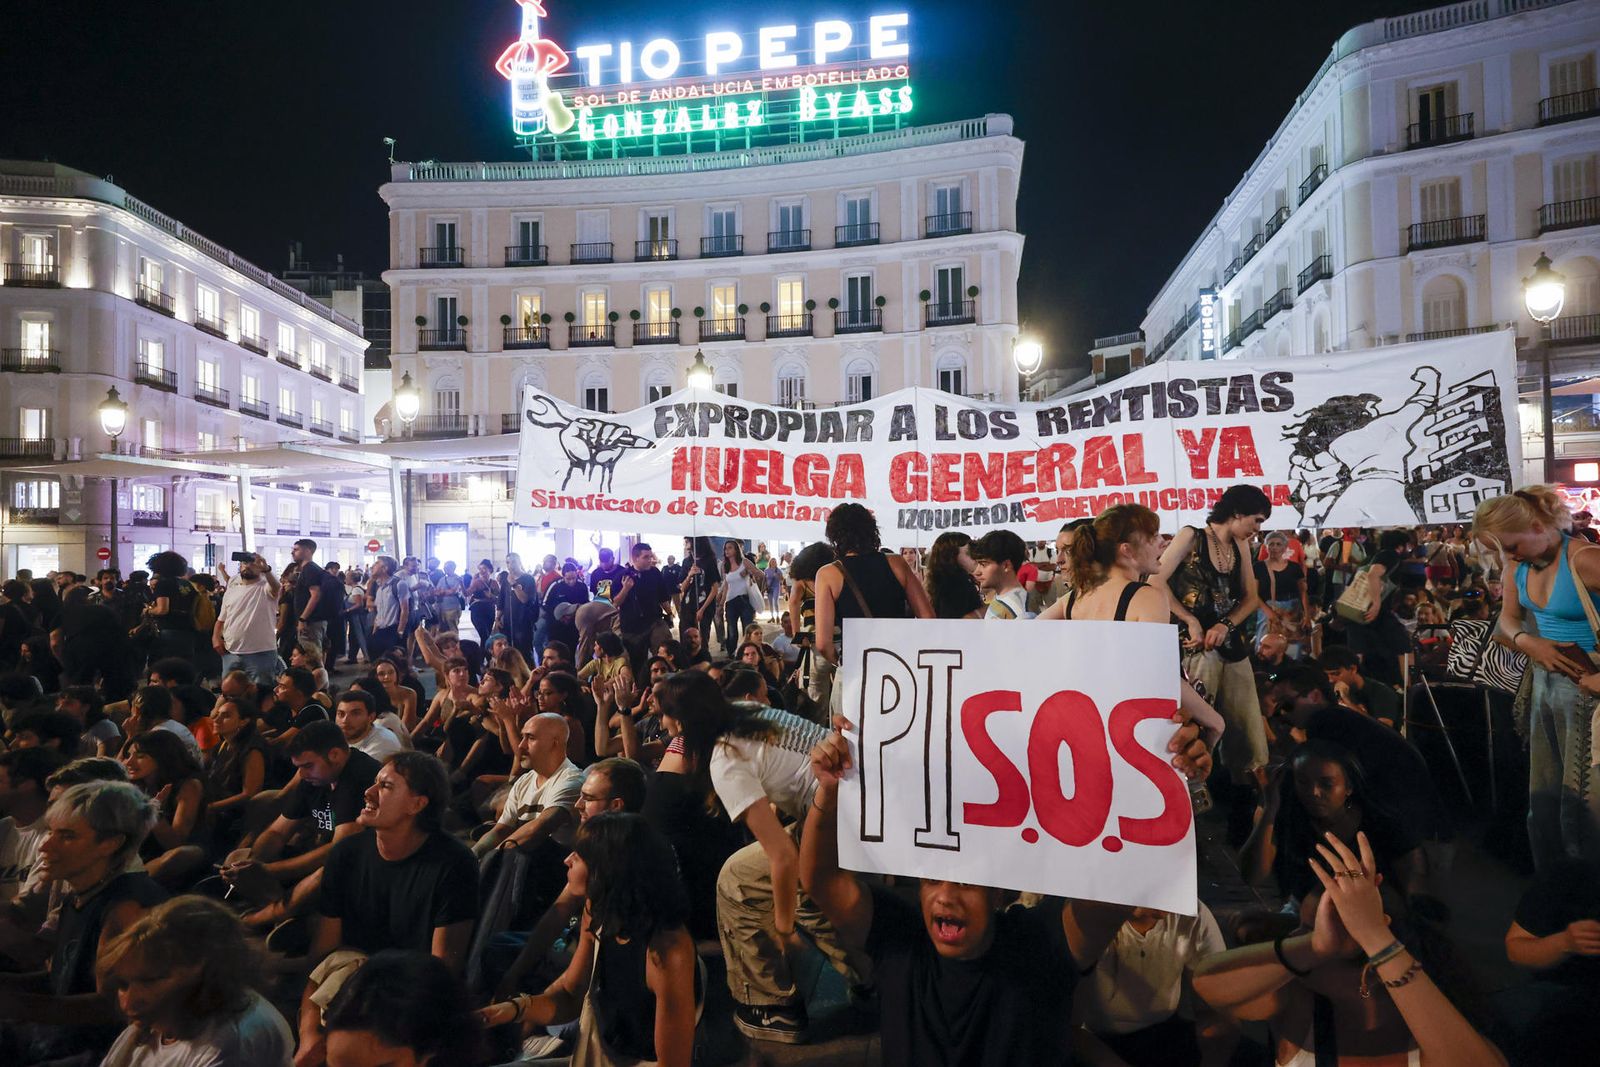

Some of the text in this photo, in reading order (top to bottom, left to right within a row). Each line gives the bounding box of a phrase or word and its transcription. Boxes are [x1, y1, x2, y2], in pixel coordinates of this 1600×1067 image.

[576, 13, 910, 86] TIO PEPE
[573, 65, 908, 109] SOL DE ANDALUCIA EMBOTELLADO
[799, 85, 914, 121] BYASS
[1200, 294, 1214, 351] HOTEL
[654, 371, 1295, 443] EXPROPIAR A LOS RENTISTAS
[671, 425, 1265, 503] HUELGA GENERAL YA
[531, 489, 875, 523] Sindicato de Estudian
[897, 502, 1026, 531] IZQUIERDA
